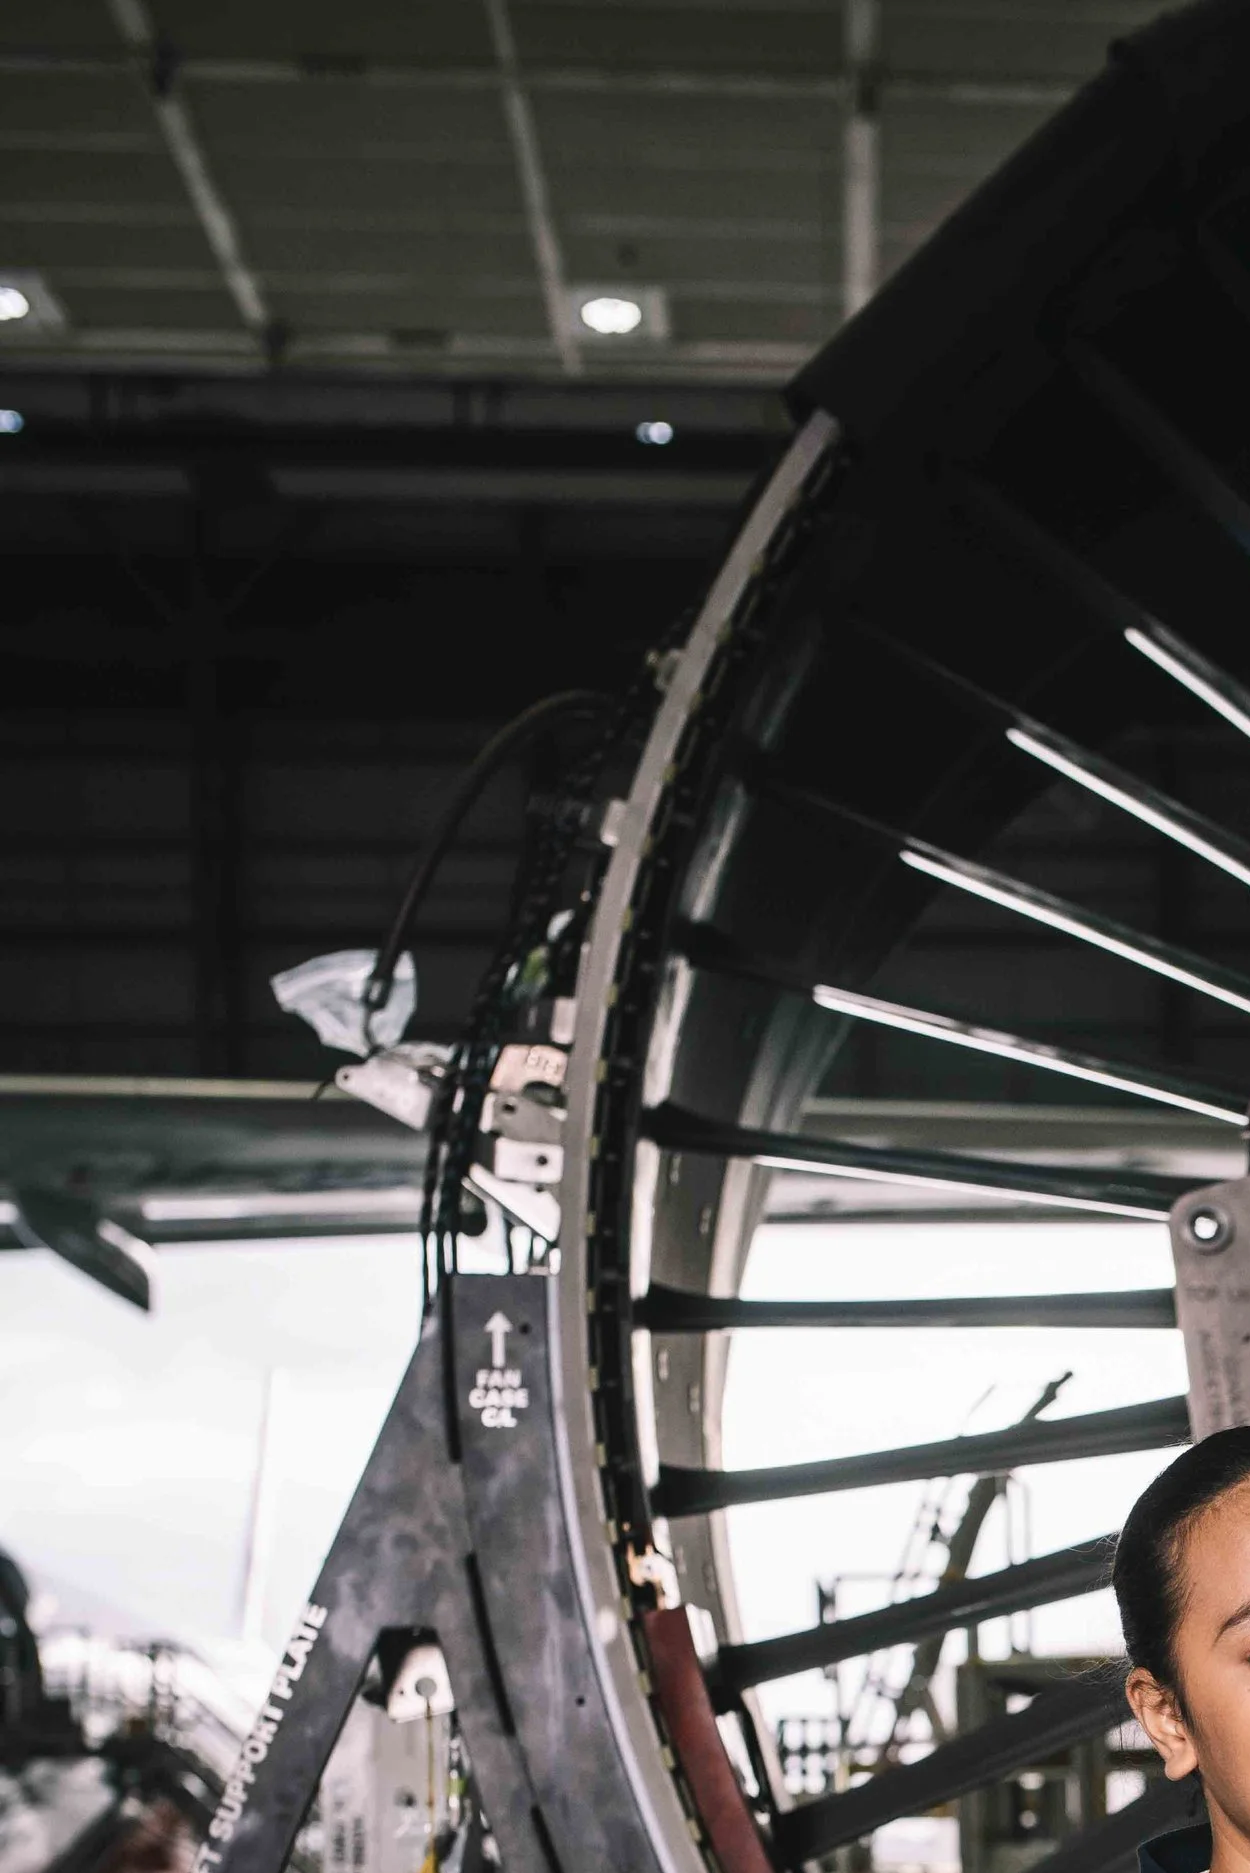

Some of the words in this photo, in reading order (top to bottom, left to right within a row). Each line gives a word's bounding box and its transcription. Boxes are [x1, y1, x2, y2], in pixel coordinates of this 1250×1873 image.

[476, 1368, 522, 1388] FAN
[209, 1701, 284, 1843] SUPPORT
[271, 1603, 328, 1700] PLATE
